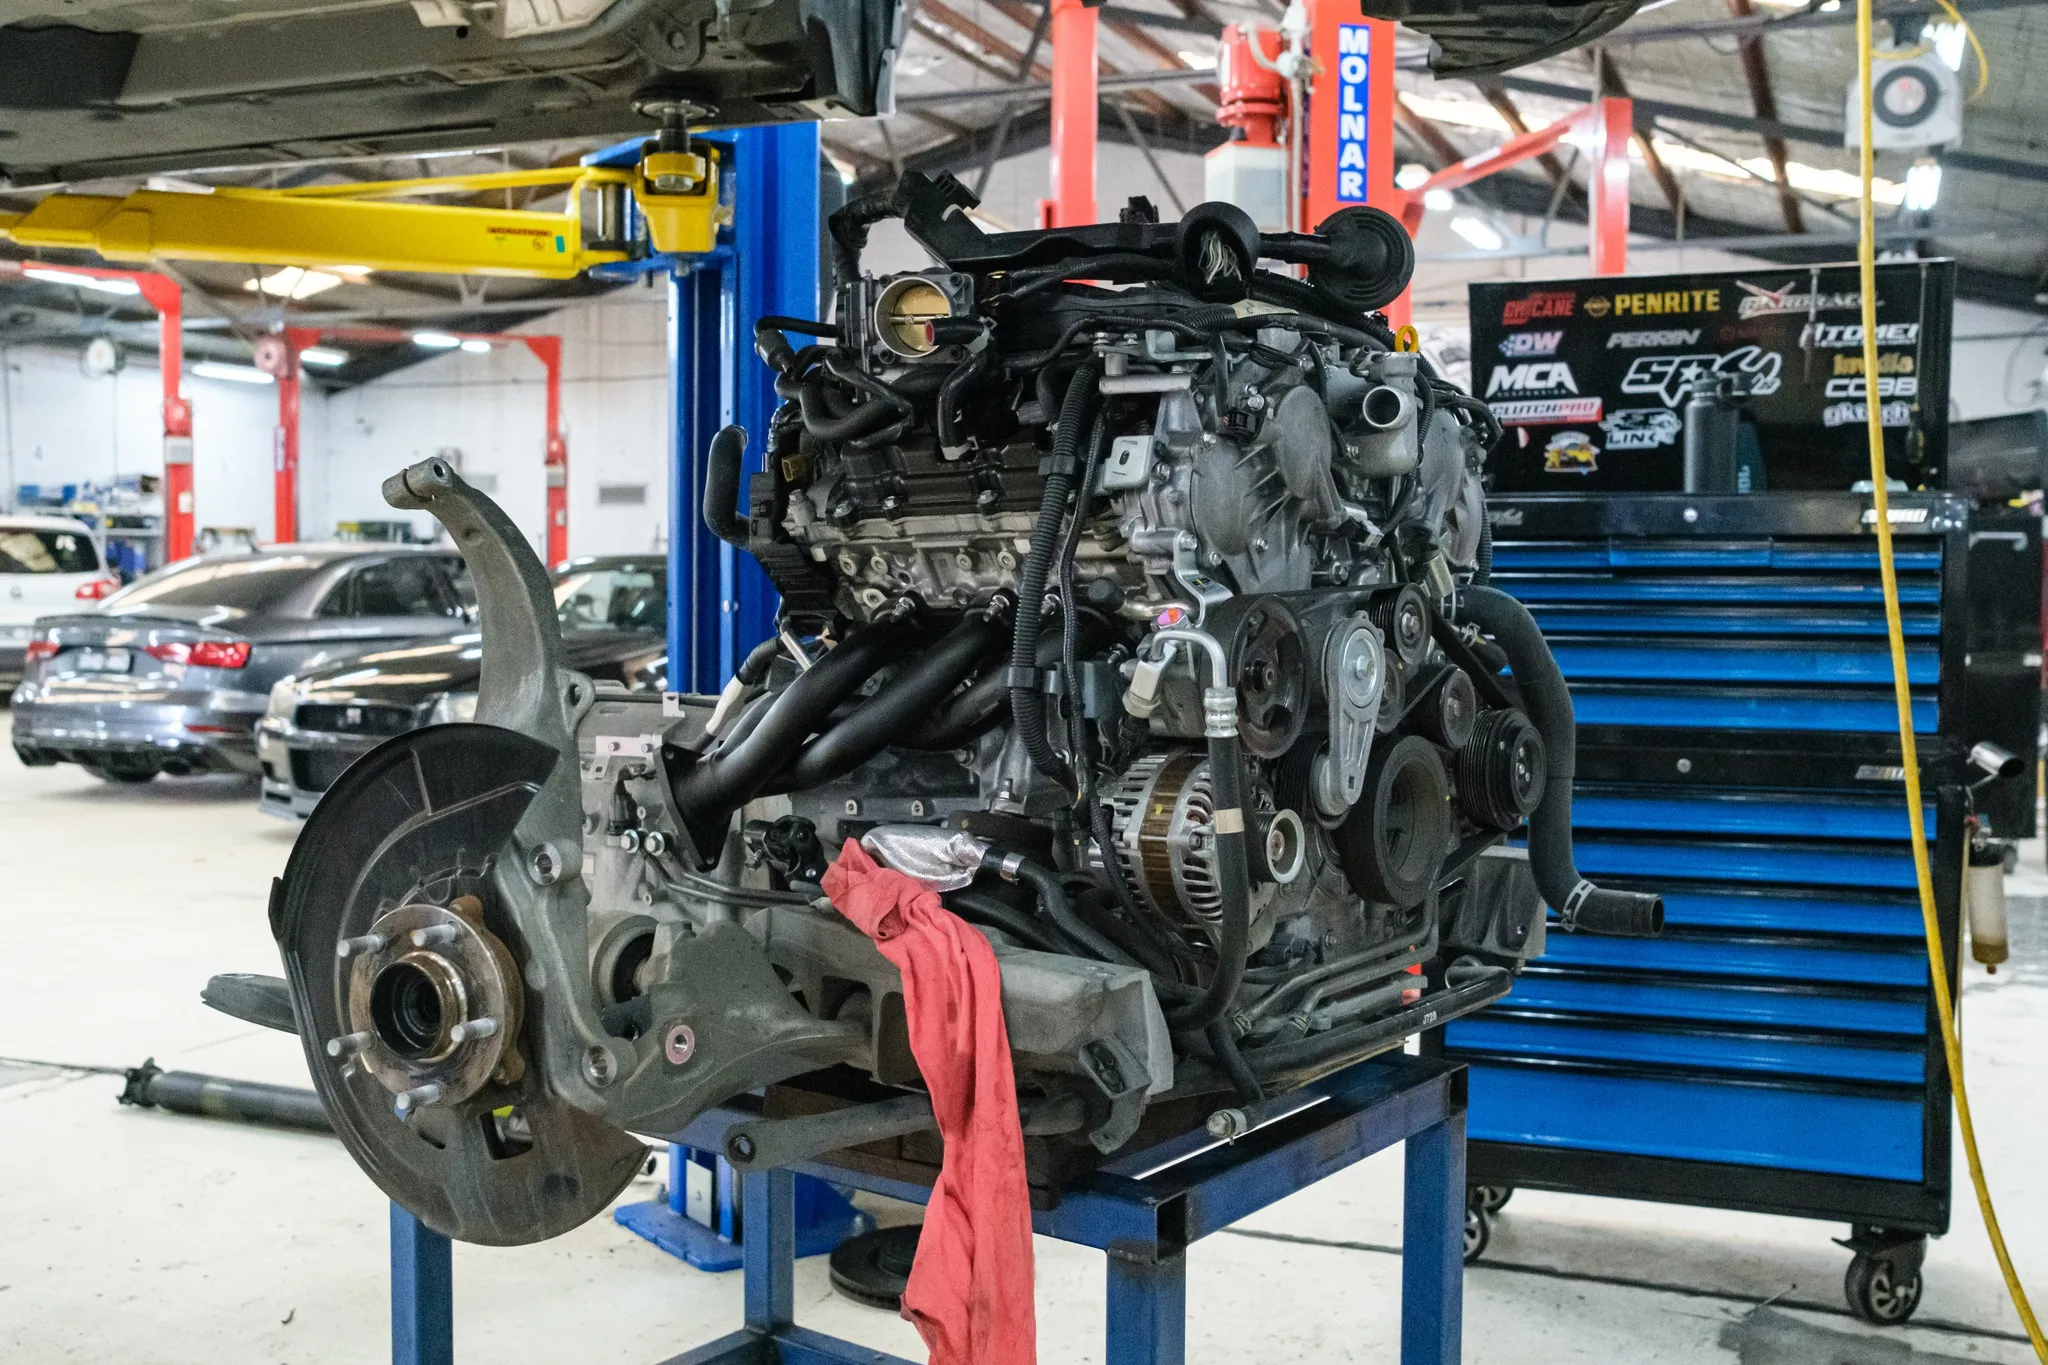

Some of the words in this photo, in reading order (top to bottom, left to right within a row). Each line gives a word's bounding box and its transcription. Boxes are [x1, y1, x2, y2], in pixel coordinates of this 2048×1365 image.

[1339, 27, 1369, 197] MOLNAR
[1615, 289, 1720, 316] PENRITE
[1514, 331, 1563, 353] DW
[1606, 329, 1702, 349] PERRIN
[1485, 362, 1579, 398] MCA
[1825, 377, 1917, 397] COBB
